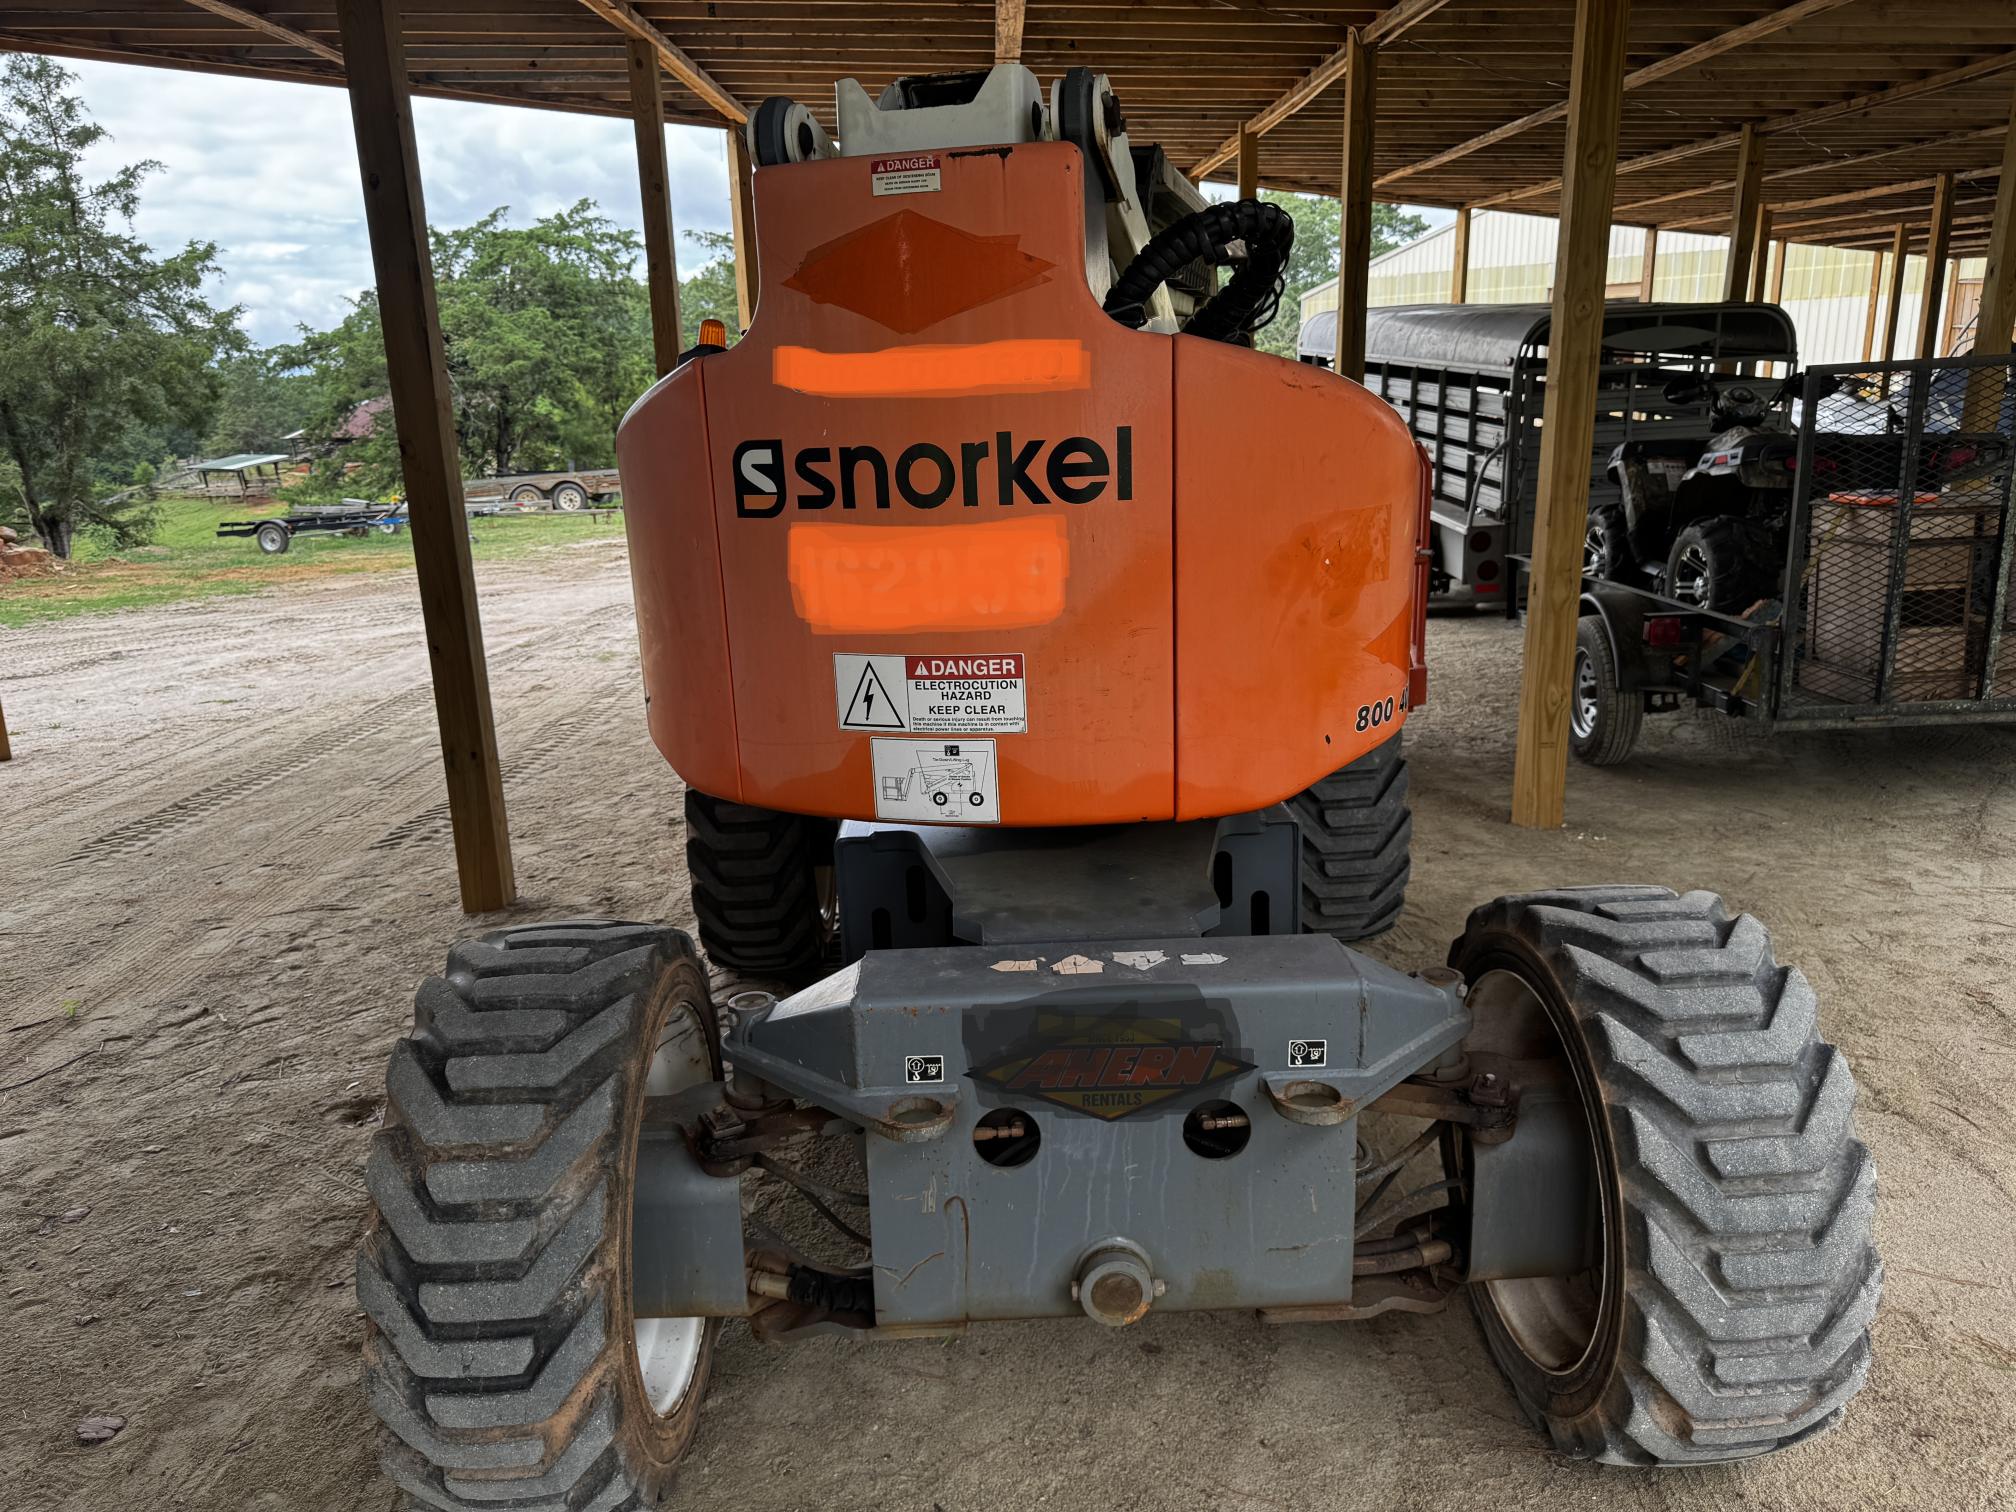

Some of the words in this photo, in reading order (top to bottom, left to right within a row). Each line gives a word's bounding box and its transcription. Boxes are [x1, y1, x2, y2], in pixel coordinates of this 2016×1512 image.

[887, 158, 935, 171] DANGER
[794, 426, 1132, 510] snorkel
[931, 659, 1016, 675] DANGER
[915, 680, 1018, 691] ELECTROCUTION
[941, 691, 992, 701] HAZARD
[929, 705, 961, 715] KEEP
[964, 705, 1006, 715] CLEAR
[1355, 696, 1394, 732] 800
[1006, 1046, 1217, 1089] AHERN
[1082, 1092, 1143, 1107] RENTALS
